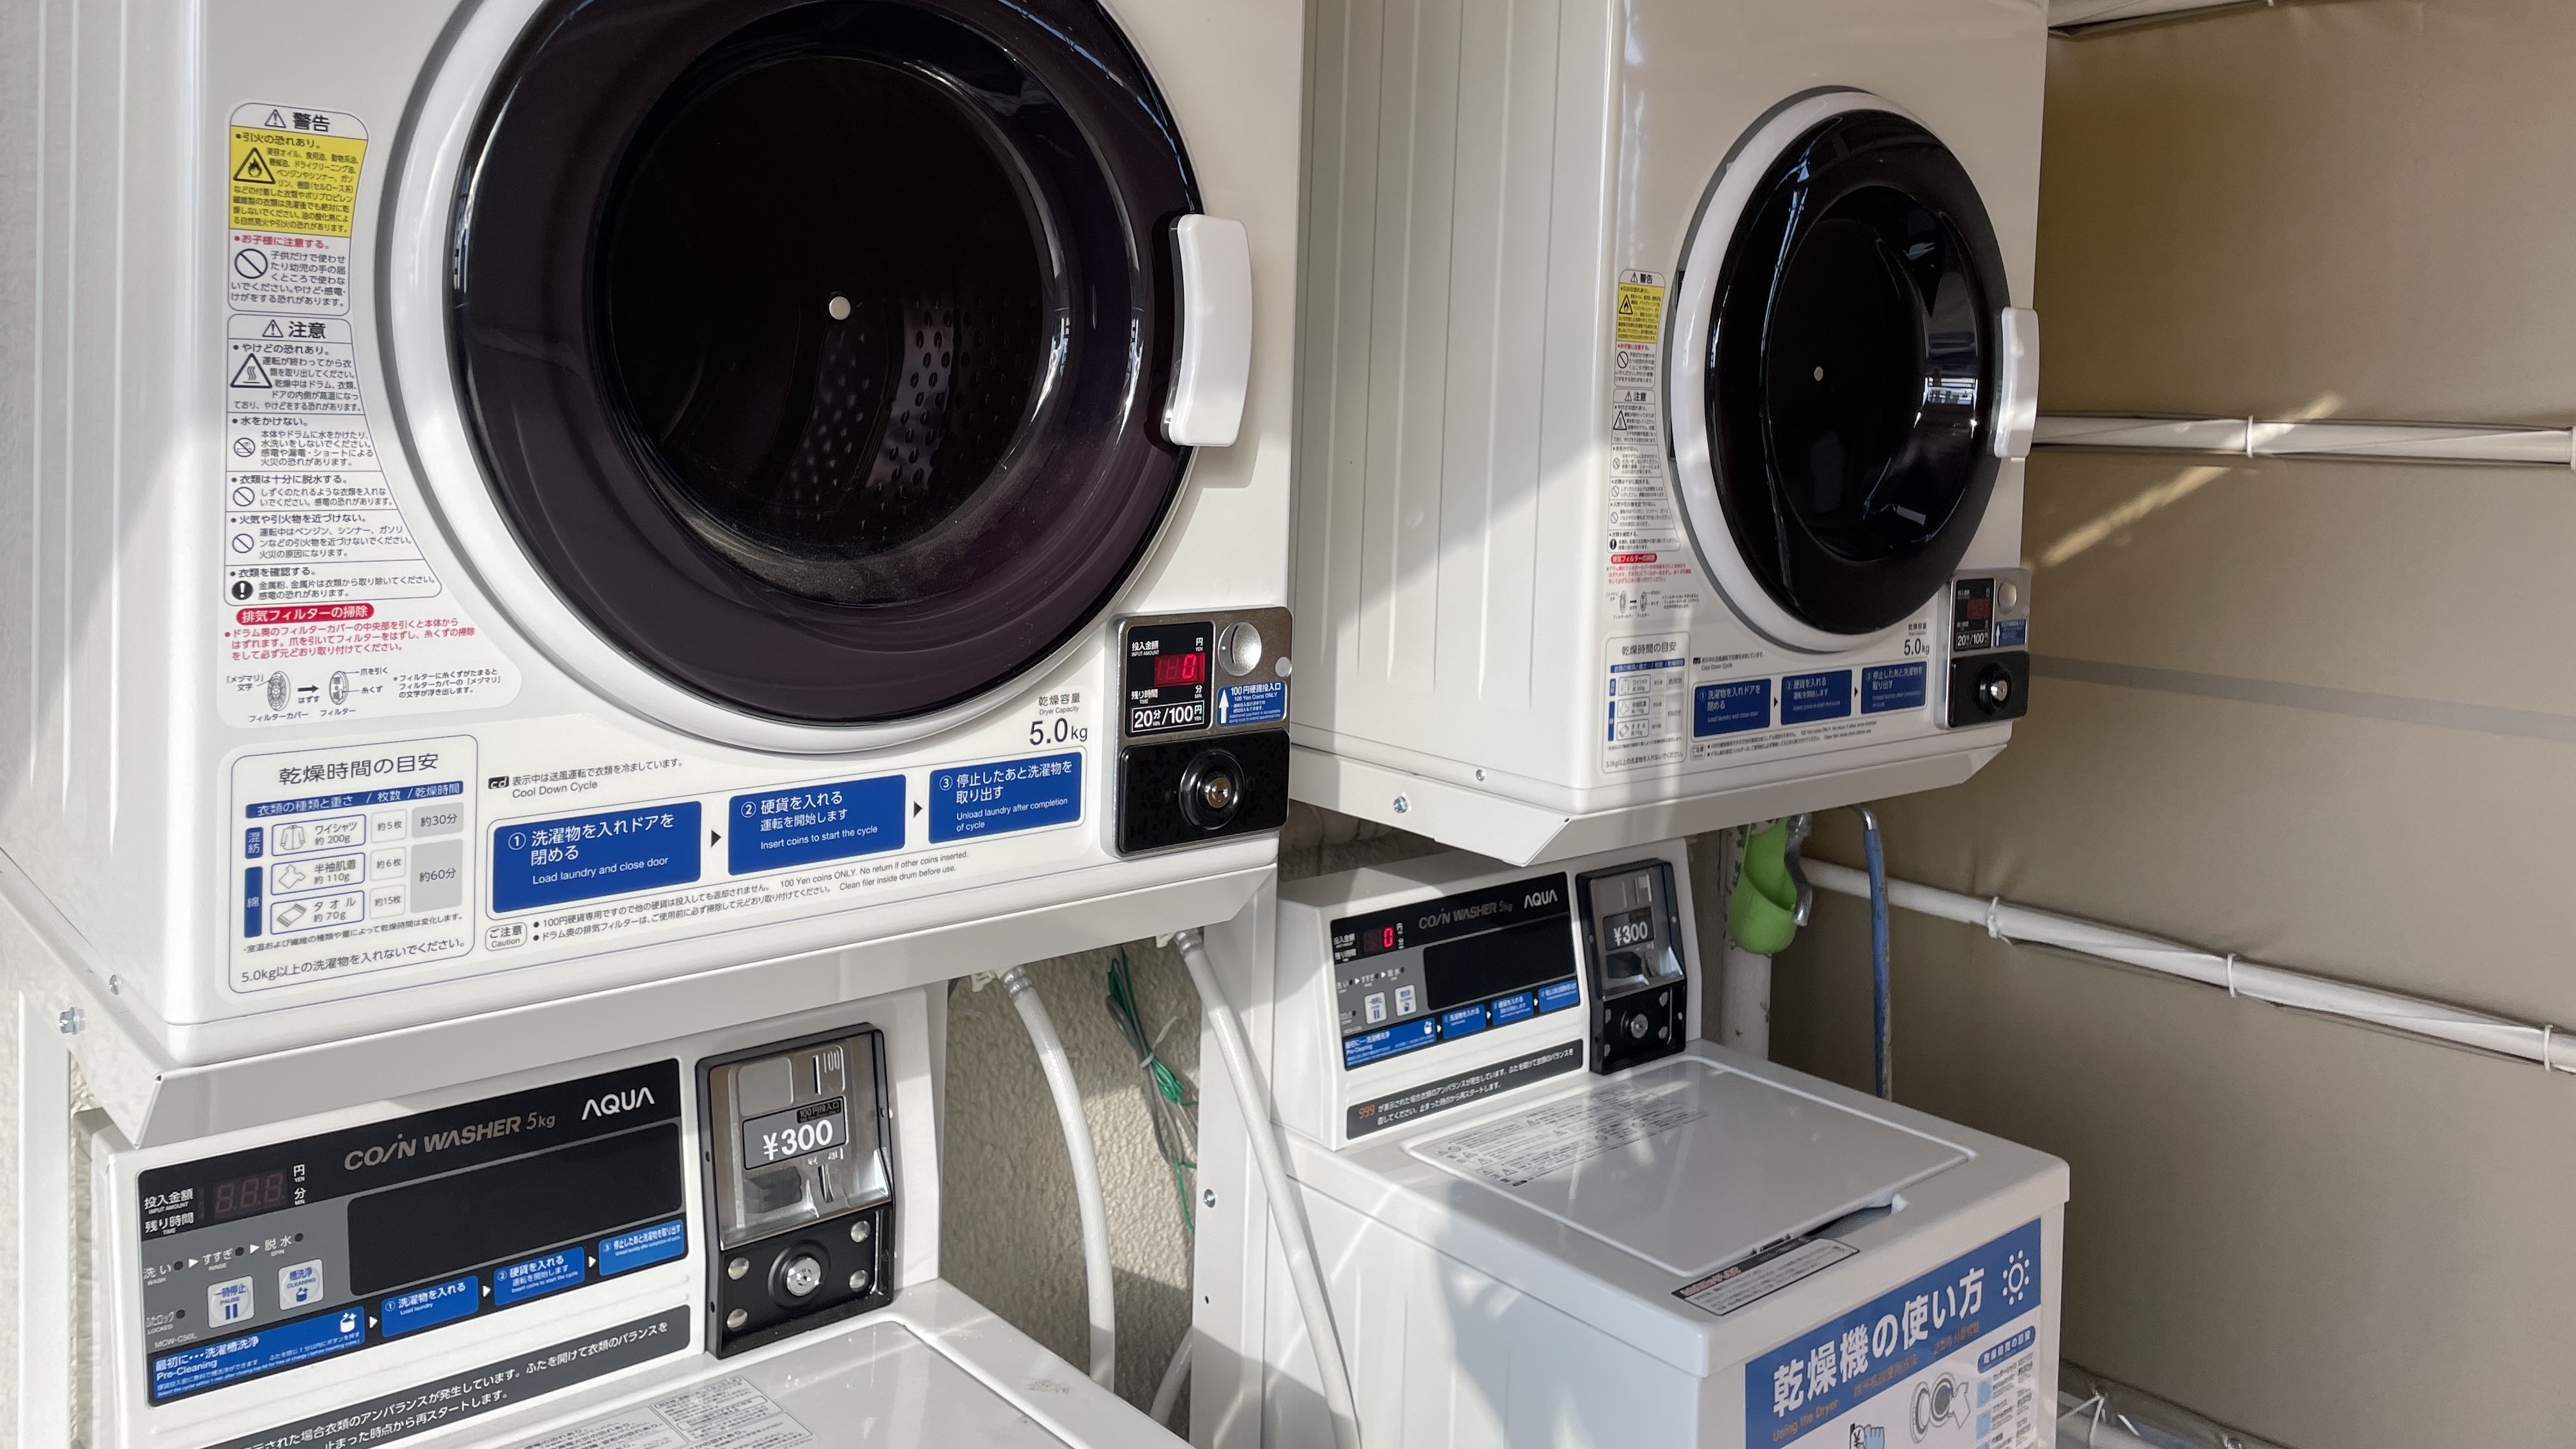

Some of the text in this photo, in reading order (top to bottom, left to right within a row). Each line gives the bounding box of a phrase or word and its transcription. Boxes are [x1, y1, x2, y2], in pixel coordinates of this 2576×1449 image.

[293, 112, 330, 132] 警告
[242, 132, 321, 149] 引火の恐れあり。
[242, 234, 329, 249] お子様に注意する。
[271, 250, 346, 263] 子供だけで使わせ
[271, 262, 346, 274] たり幼児の手の届
[271, 273, 346, 285] くところで使わな
[231, 294, 344, 307] けがをする恐れがあります。
[289, 322, 326, 339] 注意
[242, 344, 329, 355] やけどの恐れあり。
[263, 356, 351, 368] 運転が終わってから衣
[270, 368, 355, 378] 類を取り出してください。
[272, 391, 358, 400] ドアの内側が高温になっ
[241, 417, 308, 426] 水をかけない。
[261, 431, 369, 439] 本体やドラムに水をかけたり、
[260, 458, 353, 466] 火災の恐れがあります。
[240, 475, 347, 484] 衣類は十分に脱水する。
[261, 488, 386, 496] しずくのたれるような衣類を入れな
[239, 514, 367, 525] 火気や引火物を近づけない。
[259, 537, 413, 548] ンなどの引火物を近づけないでください。
[259, 549, 348, 558] 火災の原因になります。
[238, 567, 315, 578] 衣類を確認する。
[259, 576, 436, 590] 金属粉、金属片は衣類から取り除いてください。
[258, 589, 349, 600] 感電の恐れがあります。
[242, 606, 368, 623] 排気フィルターの掃除
[1132, 641, 1159, 650] 投入金額
[360, 667, 388, 676] 爪を引く
[362, 686, 383, 694] 糸くず
[399, 687, 474, 698] の文字が浮き出します。
[1131, 689, 1158, 700] 残り時間
[1038, 693, 1080, 706] 乾燥容量
[249, 711, 309, 722] フィルターカバー
[320, 707, 356, 717] フィルター
[1056, 705, 1078, 714] Capacity
[279, 753, 438, 785] 乾燥時間の目安
[512, 759, 682, 786] 表示中は送風運転で衣類を冷ましています。
[956, 761, 1072, 788] 停止したあと洗濯物を
[512, 780, 597, 799] Cool Down Cycle
[956, 786, 1004, 804] 取り出す
[257, 795, 353, 816] 衣類の種類と重さ
[760, 792, 843, 815] 硬貨を入れる
[956, 797, 1068, 821] Unload laundry after completion
[420, 813, 457, 827] 約30分
[760, 808, 848, 832] 運転を開始します
[956, 820, 985, 832] of cycle
[315, 822, 358, 835] ワイシャツ
[531, 813, 674, 847] 洗濯物を入れドアを
[760, 825, 878, 850] Insert coins to start the cycle
[531, 846, 579, 866] 閉める
[314, 859, 356, 873] 半袖肌着
[533, 855, 668, 884] Load laundry and close door
[781, 879, 794, 888] 100
[796, 877, 811, 885] Yen
[813, 873, 832, 883] coins
[834, 869, 857, 879] ONLY.
[872, 863, 893, 872] return
[901, 859, 918, 868] other
[920, 856, 938, 865] coins
[940, 851, 969, 861] inserted.
[419, 868, 456, 882] 約60分
[840, 881, 860, 891] Clean
[877, 875, 897, 885] inside
[900, 871, 917, 880] drum
[919, 868, 940, 877] before
[1419, 908, 1450, 930] COIN
[1453, 902, 1497, 923] WASHER
[1524, 890, 1558, 909] AQUA
[489, 925, 523, 939] ご注意
[1614, 921, 1648, 946] ¥300
[491, 937, 520, 948] Caution
[241, 939, 464, 983] 5.0kg以上の洗濯物を入れないでください。
[344, 1087, 655, 1171] COIN WASHER 5kg AQUA
[763, 1119, 832, 1160] ¥300
[144, 1164, 305, 1210] 投入金額 円
[145, 1187, 306, 1233] 残り時間 分
[165, 1202, 188, 1211] AMOUNT
[203, 1248, 233, 1265] すすぎ
[287, 1277, 316, 1289] CLEANING
[215, 1284, 245, 1297] 一時停止
[398, 1282, 466, 1308] 洗濯物を入れる
[148, 1323, 174, 1335] LOCKED
[1773, 1266, 1985, 1418] 乾燥機の使い方
[157, 1360, 217, 1381] Pre-Cleaning
